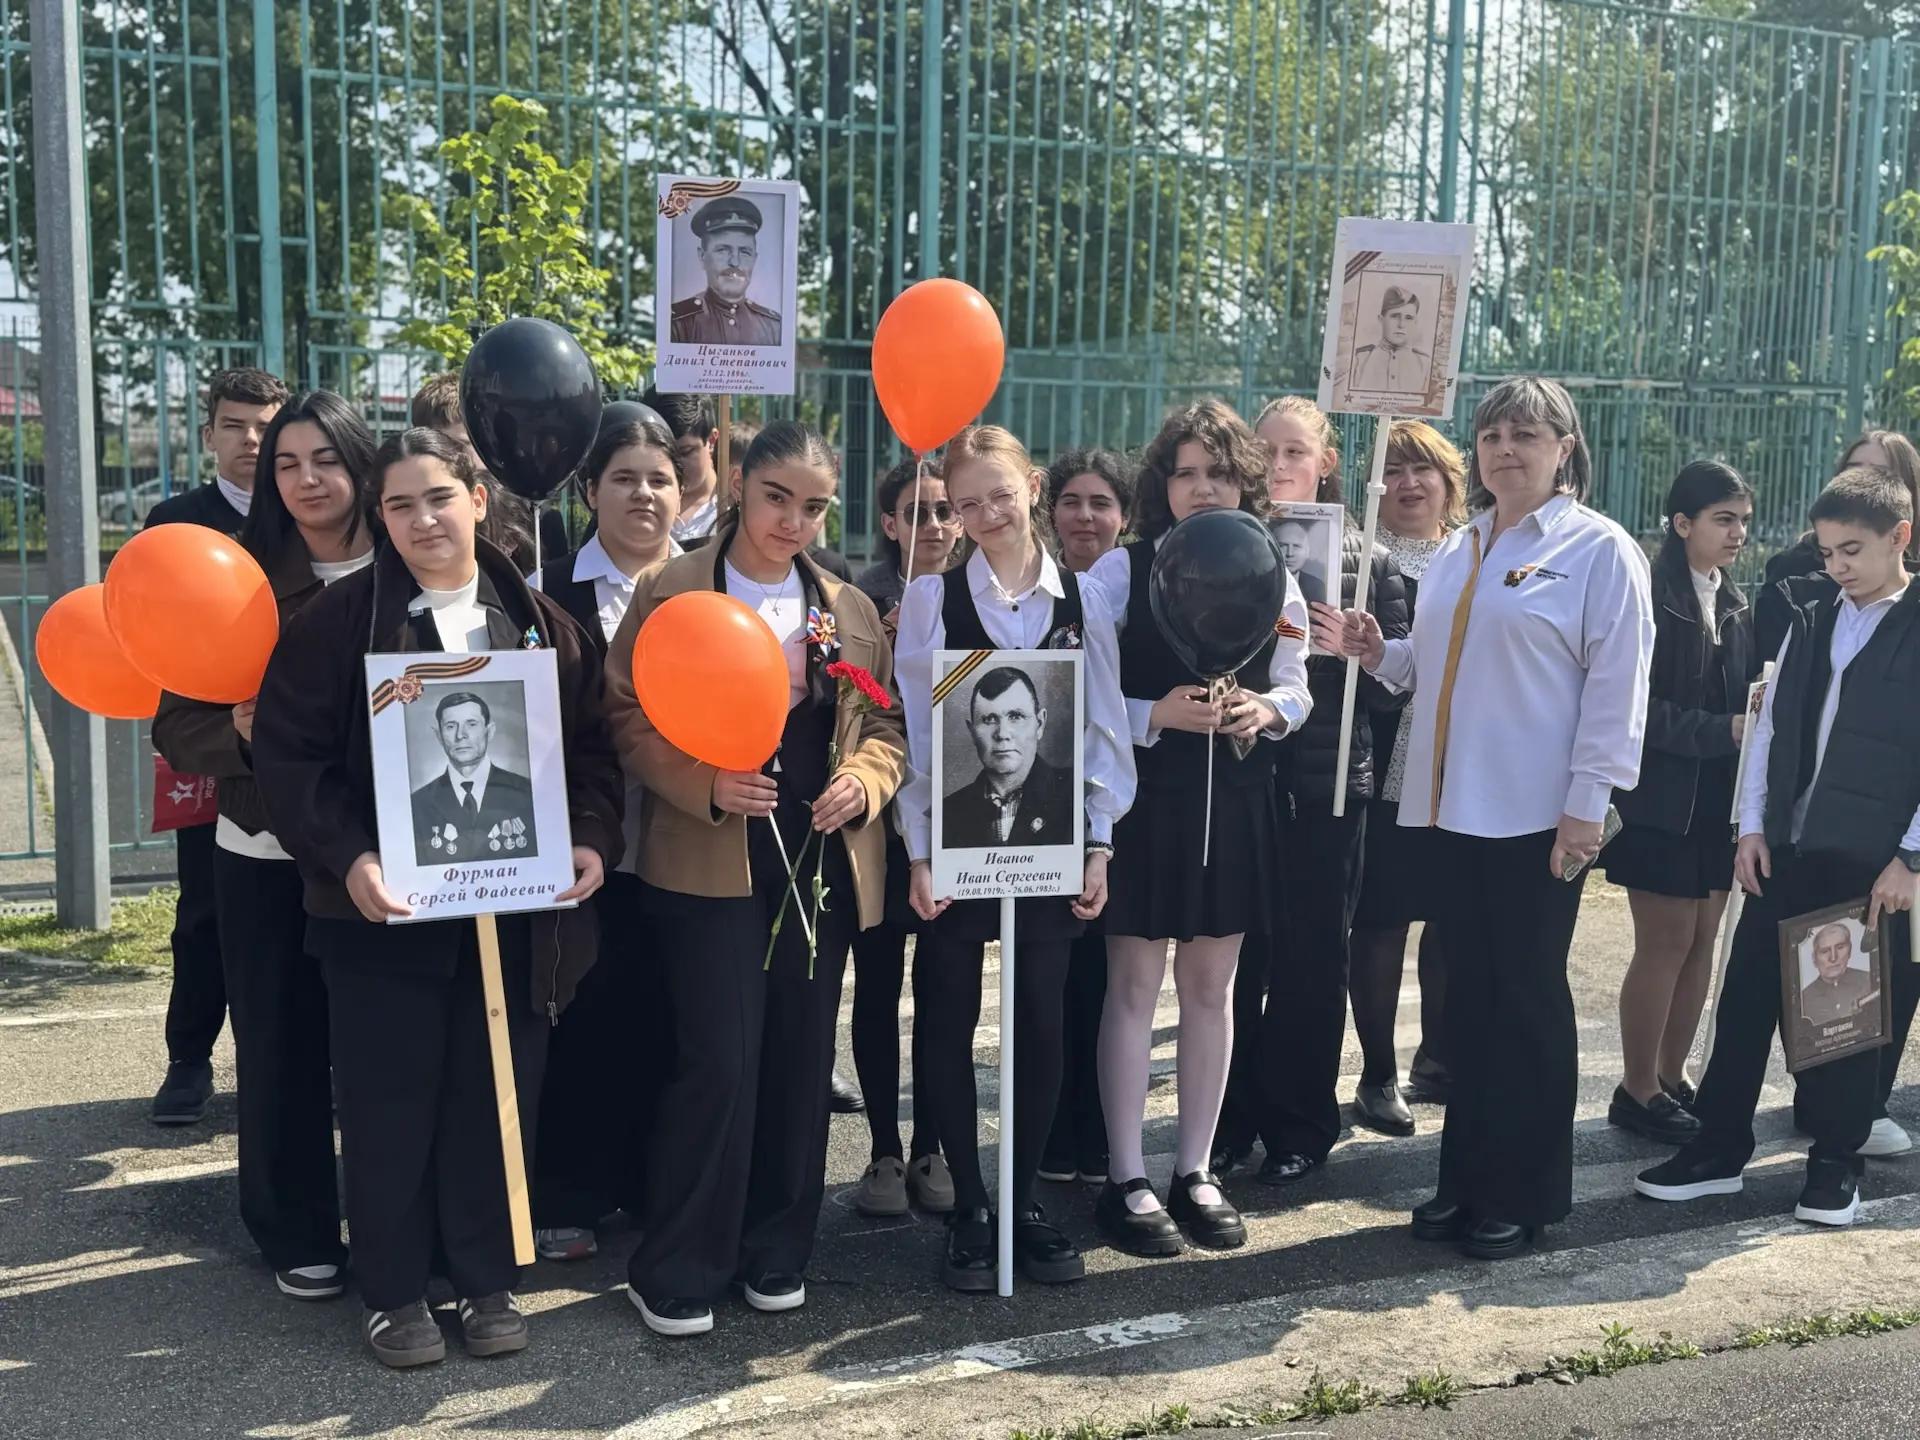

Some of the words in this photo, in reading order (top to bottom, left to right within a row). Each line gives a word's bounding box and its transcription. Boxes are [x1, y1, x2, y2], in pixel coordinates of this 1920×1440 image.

[698, 345, 756, 356] Цыганков
[664, 355, 704, 366] Данил
[710, 356, 787, 368] Степанович
[984, 852, 1034, 865] Иванов
[443, 866, 518, 885] Фурман
[956, 871, 991, 884] Иван
[995, 869, 1061, 885] Сергеевич
[407, 889, 468, 908] Сергей
[474, 883, 556, 899] Фадеевич
